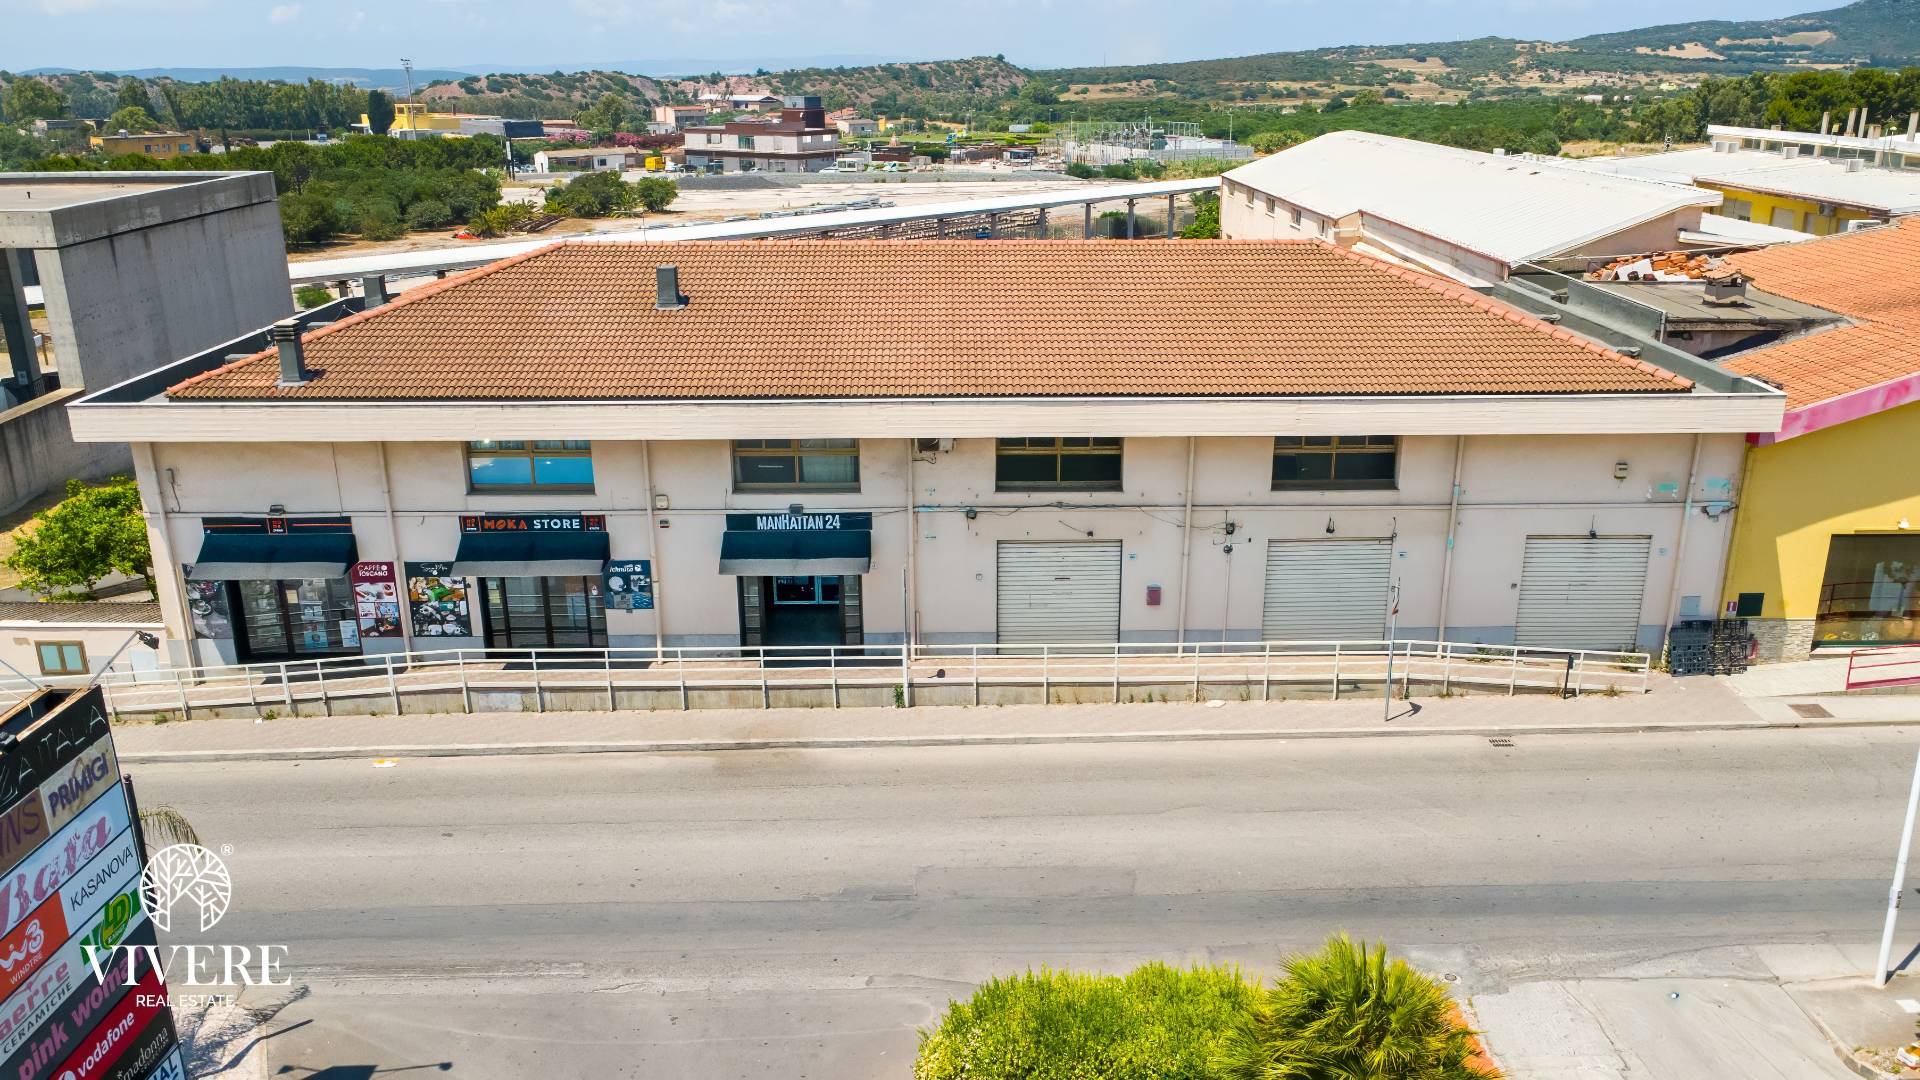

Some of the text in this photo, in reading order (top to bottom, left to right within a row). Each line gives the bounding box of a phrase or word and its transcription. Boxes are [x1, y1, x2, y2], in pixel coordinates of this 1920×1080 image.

[484, 518, 528, 530] MOKA
[533, 518, 581, 530] STORE
[756, 514, 841, 531] MANHATTAN 24
[37, 704, 107, 764] ITALIA
[48, 752, 110, 818] PRIMIGI
[70, 846, 134, 911] KASANOVA
[10, 953, 44, 985] WINDTRE
[4, 982, 73, 1055] CERAMICHE
[77, 1011, 136, 1077] vodafone
[17, 1021, 70, 1080] pink
